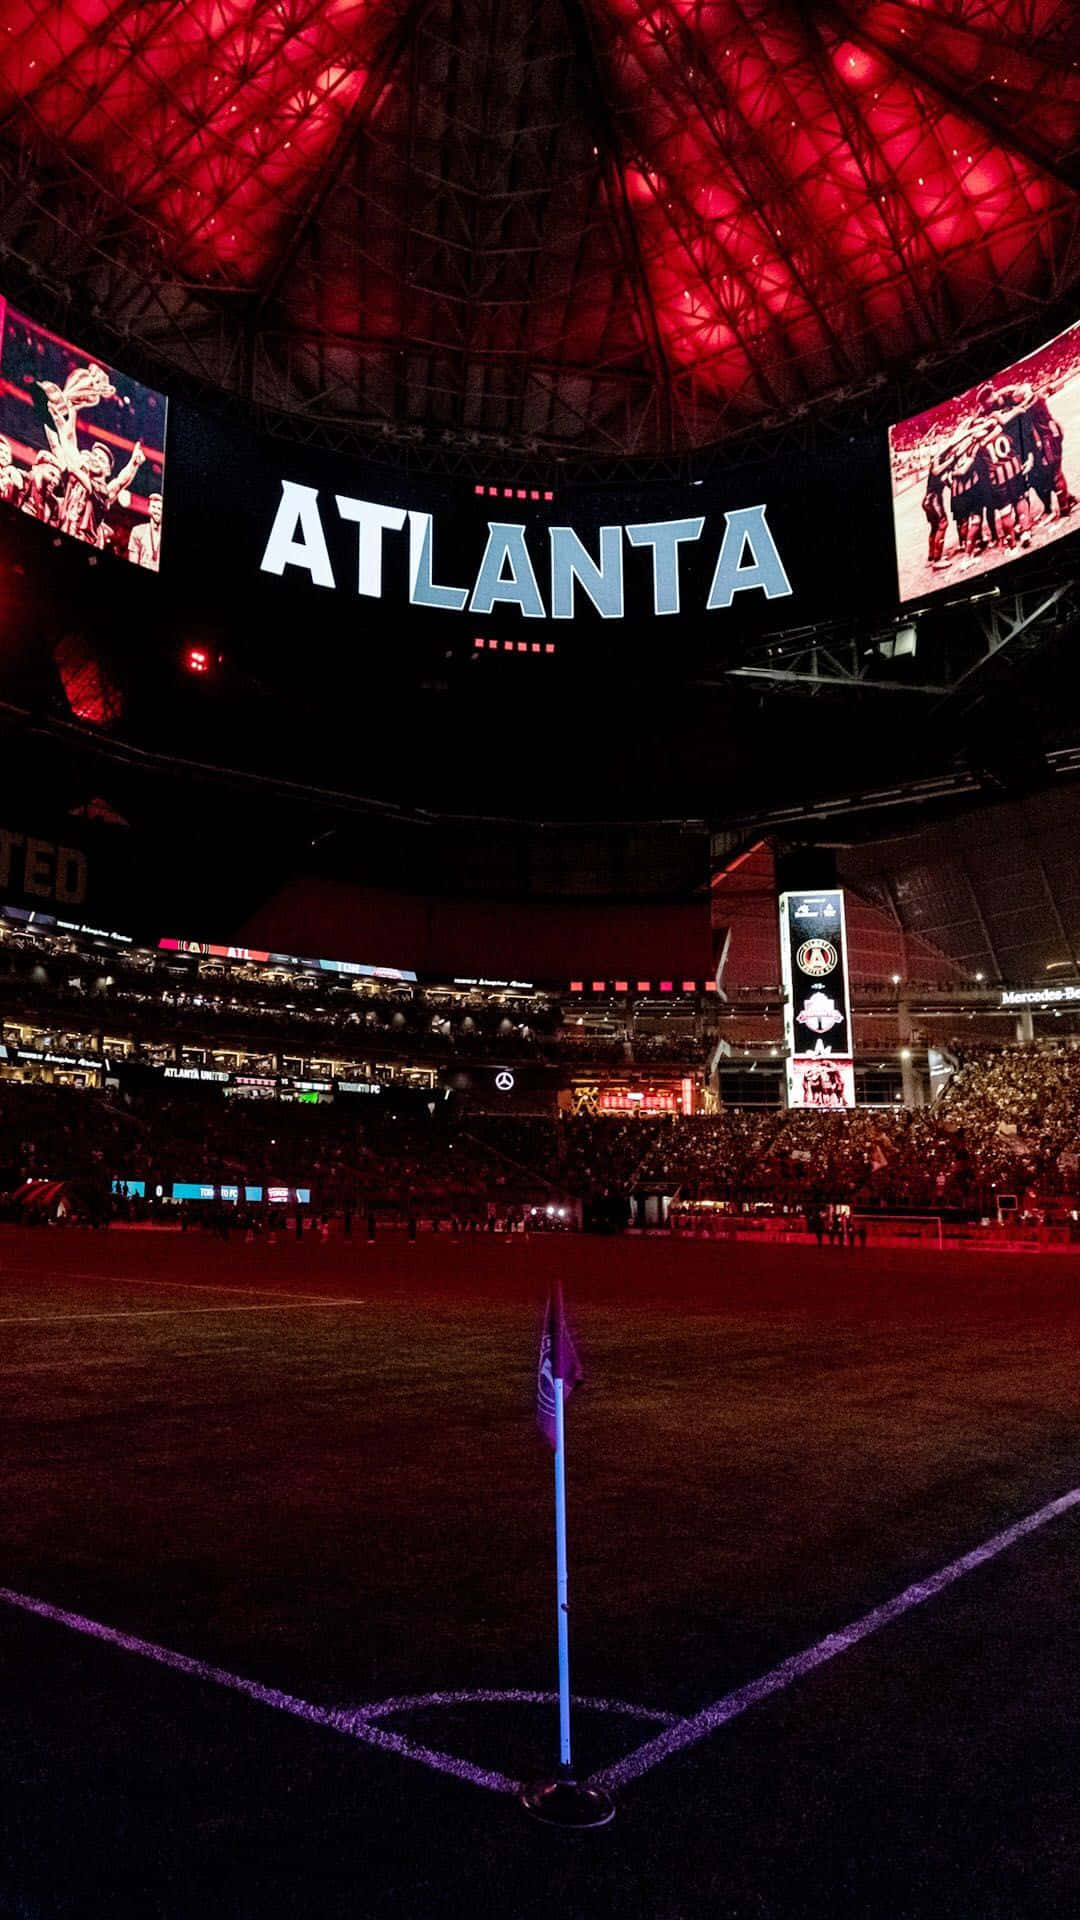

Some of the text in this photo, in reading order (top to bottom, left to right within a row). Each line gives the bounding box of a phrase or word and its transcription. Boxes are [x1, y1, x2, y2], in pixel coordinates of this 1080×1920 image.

[986, 435, 1012, 461] 10
[260, 479, 794, 619] ATLANTA
[227, 946, 252, 960] ATL
[164, 1067, 199, 1080] ATLANTA
[370, 1084, 380, 1094] FC
